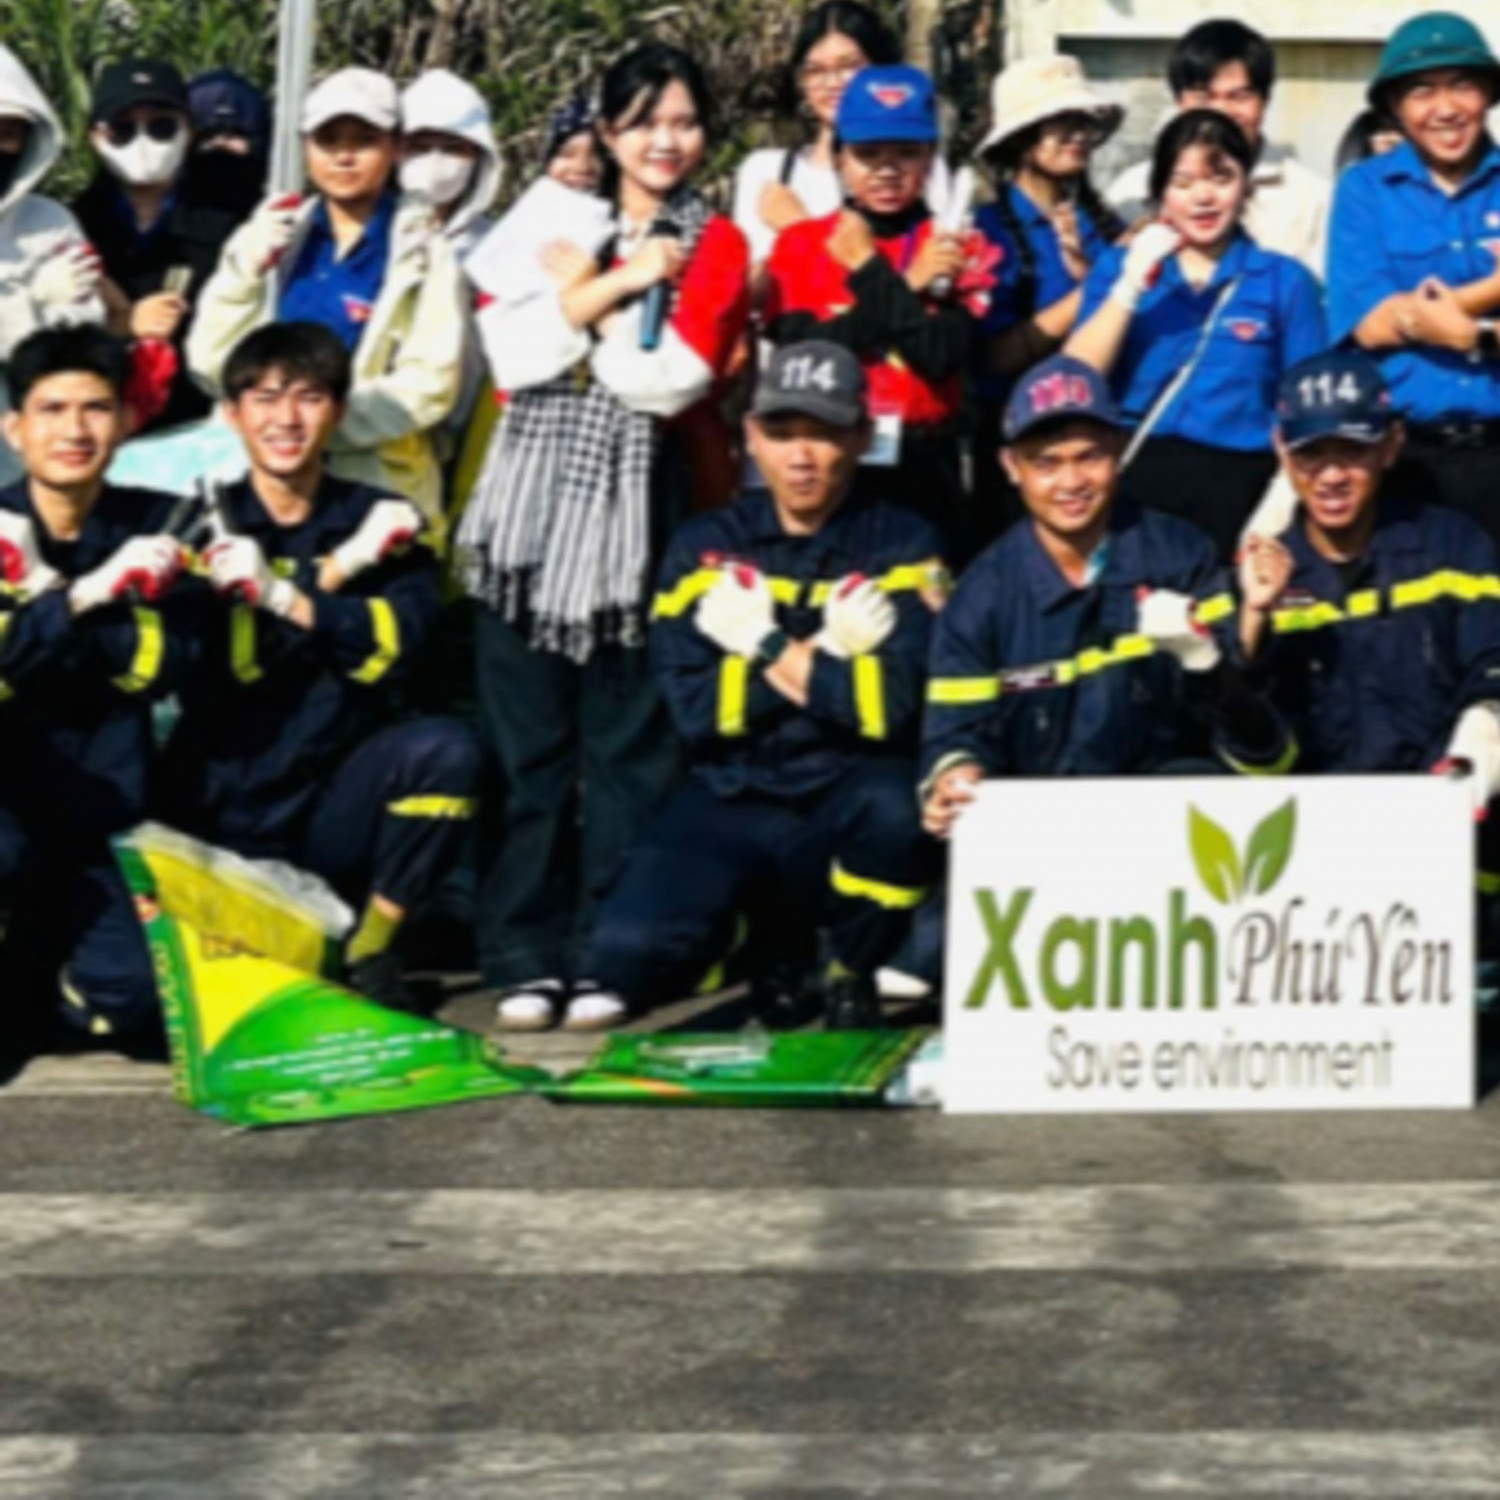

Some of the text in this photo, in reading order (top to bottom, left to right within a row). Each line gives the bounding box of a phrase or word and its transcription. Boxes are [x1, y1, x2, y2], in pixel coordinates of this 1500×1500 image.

[781, 355, 836, 390] 114
[1299, 372, 1361, 406] 114
[962, 887, 1219, 1012] Xanh
[1046, 1024, 1396, 1092] Save environment
